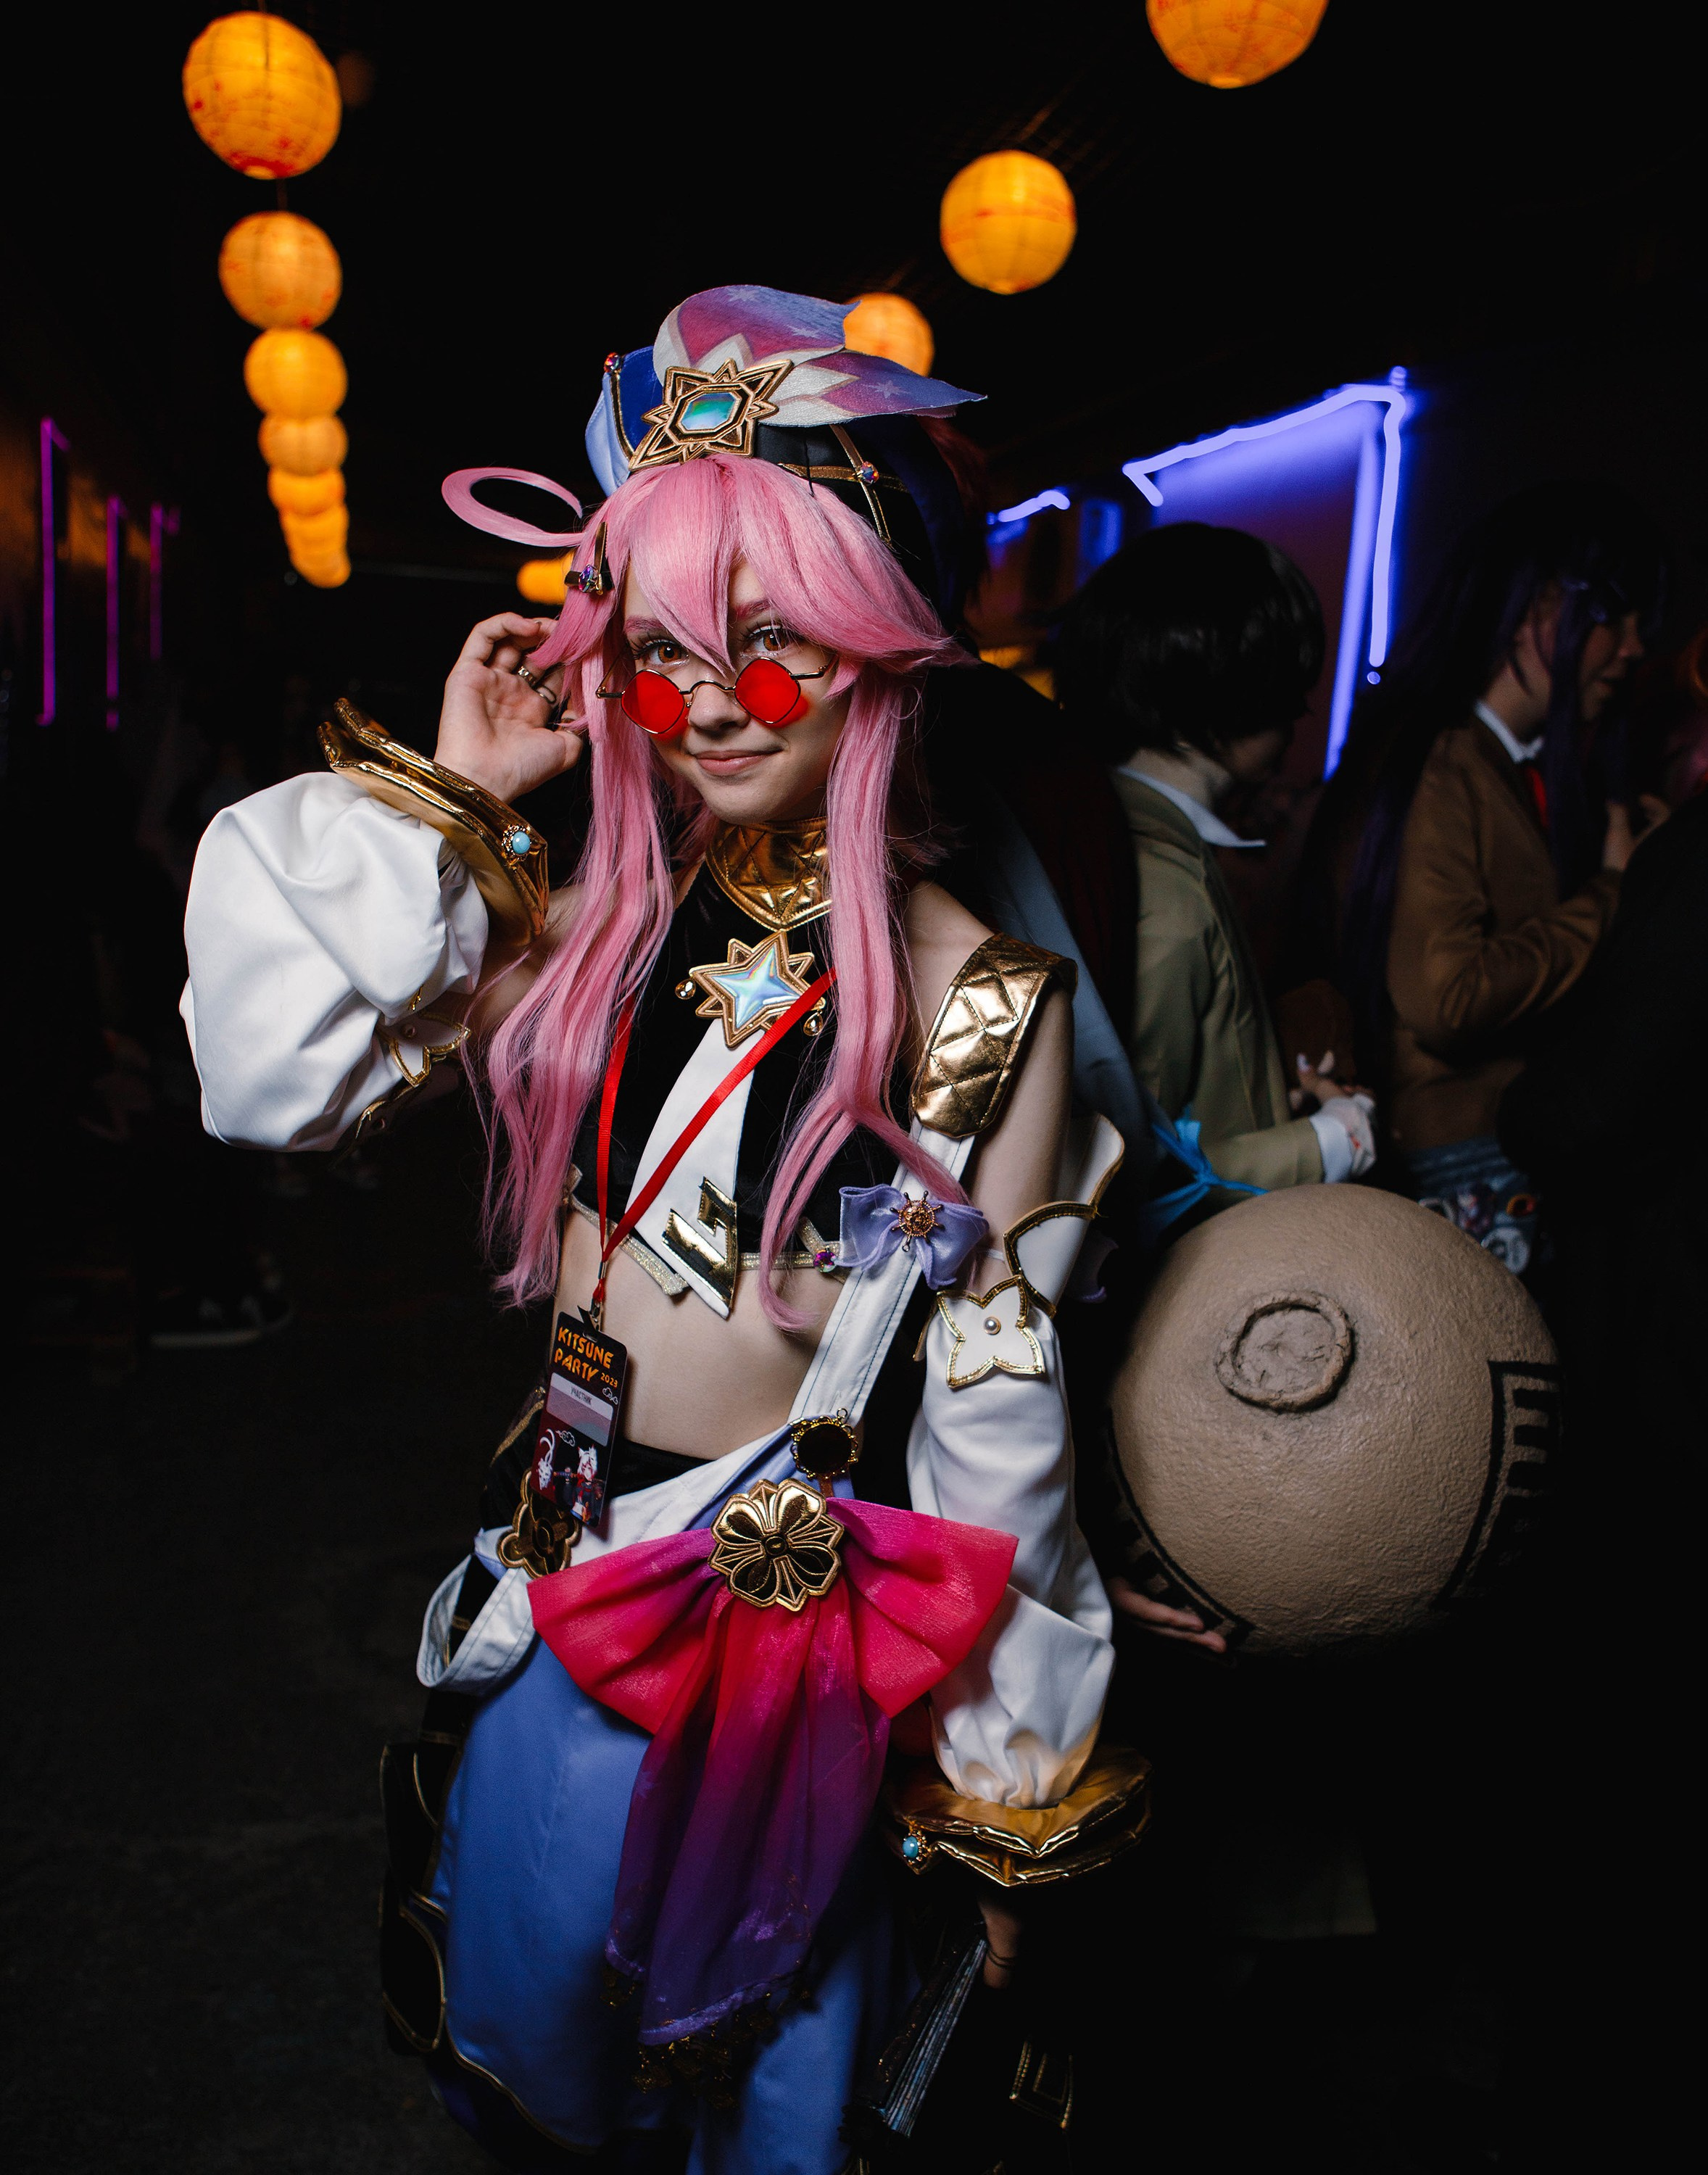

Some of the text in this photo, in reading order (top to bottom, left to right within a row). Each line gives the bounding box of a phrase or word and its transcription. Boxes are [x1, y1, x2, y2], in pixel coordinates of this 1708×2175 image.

[554, 1348, 618, 1388] PARTY 2023
[557, 1326, 614, 1369] KITSUNE
